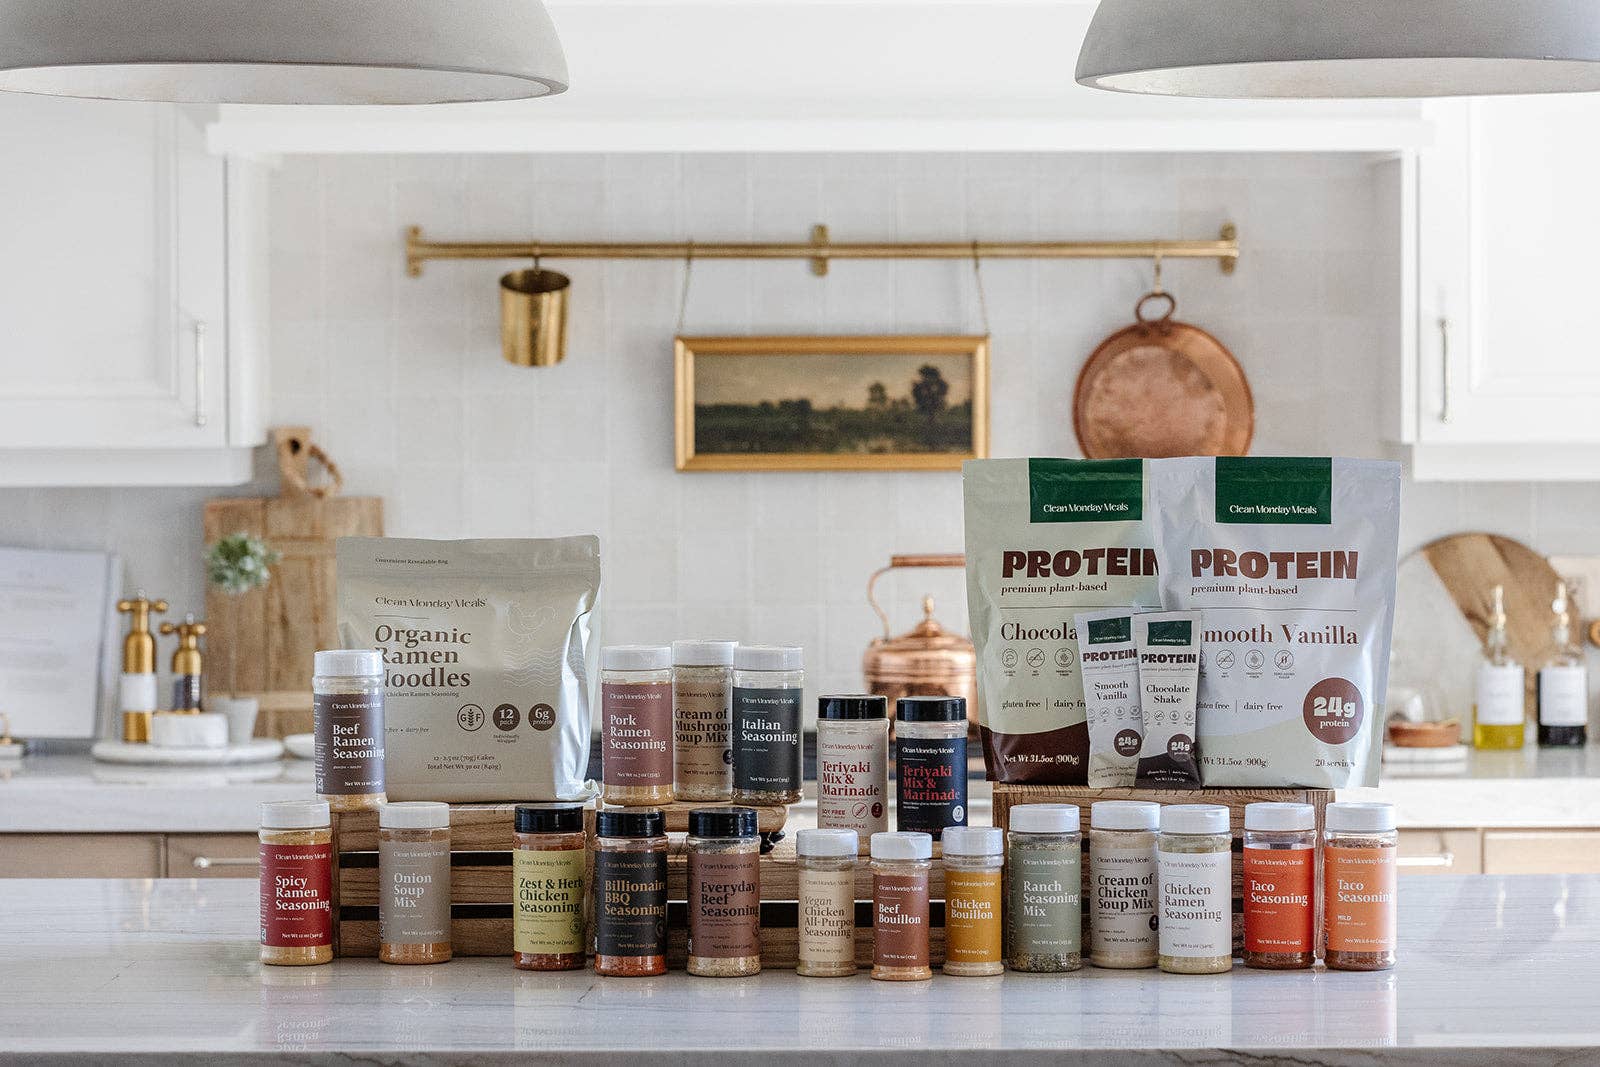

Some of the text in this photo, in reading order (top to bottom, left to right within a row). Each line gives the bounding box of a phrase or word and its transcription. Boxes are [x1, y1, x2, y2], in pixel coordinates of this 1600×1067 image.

[1044, 503, 1128, 513] Clean Monday Meals
[1230, 504, 1317, 515] Clean Monday Meals
[1002, 548, 1159, 578] PROTEIN
[1191, 548, 1358, 579] PROTEIN
[1001, 582, 1107, 596] premium plant-based
[1191, 583, 1298, 595] premium plant-based
[376, 597, 486, 609] Clean Monday Meals
[375, 625, 471, 647] Organic
[1000, 622, 1077, 641] Chocola
[1200, 624, 1358, 645] mooth Vanilla
[1083, 649, 1137, 662] PROTEIN
[1141, 654, 1196, 663] PROTEIN
[1095, 680, 1128, 690] Smooth
[1146, 684, 1190, 693] Chocolate
[1096, 692, 1127, 701] Vanilla
[1154, 694, 1182, 704] Shake
[1054, 700, 1073, 709] dairy
[1244, 703, 1263, 712] dairy
[1314, 697, 1356, 717] 24g
[499, 709, 513, 718] 12
[535, 708, 549, 720] 6g
[610, 714, 636, 725] Pork
[676, 708, 728, 720] Cream of
[333, 724, 360, 735] Beef
[742, 719, 781, 730] Italian
[1320, 719, 1349, 729] protein
[610, 727, 651, 737] Ramen
[742, 731, 797, 745] Seasoning
[333, 736, 375, 747] Ramen
[676, 733, 728, 744] Soup Mix
[610, 739, 666, 752] Seasoning
[1171, 742, 1190, 751] 24g
[333, 748, 384, 760] Seasoning
[1004, 754, 1079, 765] Net Wt 31.5oz (900g)
[822, 761, 870, 774] Teriyaki
[1203, 757, 1214, 765] Wt
[1217, 758, 1242, 766] 31.5oz
[903, 764, 952, 777] Teriyaki
[822, 774, 854, 784] Mix &
[903, 777, 936, 788] Mix &
[822, 785, 879, 796] Marinade
[903, 789, 960, 801] Marinade
[276, 875, 307, 889] Spicy
[394, 872, 432, 884] Onion
[520, 878, 543, 889] Zest
[546, 878, 556, 889] &
[1098, 872, 1153, 886] Cream of
[394, 884, 424, 898] Soup
[701, 881, 756, 896] Everyday
[1023, 880, 1062, 892] Ranch
[1165, 883, 1211, 895] Chicken
[1251, 880, 1275, 892] Taco
[1339, 879, 1364, 891] Taco
[276, 887, 318, 898] Ramen
[520, 889, 569, 902] Chicken
[1098, 886, 1148, 898] Chicken
[276, 899, 329, 911] Seasoning
[394, 898, 416, 908] Mix
[605, 894, 630, 906] BBQ
[701, 894, 729, 905] Beef
[805, 896, 832, 907] Vegan
[951, 898, 991, 909] Chicken
[1023, 892, 1079, 906] Seasoning
[1165, 896, 1205, 907] Ramen
[1251, 893, 1308, 907] Seasoning
[520, 902, 580, 914] Seasoning
[605, 905, 665, 917] Seasoning
[879, 903, 899, 914] Beef
[1023, 905, 1046, 917] Mix
[1098, 898, 1154, 913] Soup Mix
[701, 906, 759, 918] Seasoning
[805, 907, 845, 917] Chicken
[951, 909, 993, 920] Bouillon
[1165, 908, 1222, 922] Seasoning
[879, 914, 921, 925] Bouillon
[804, 927, 851, 939] Seasoning
